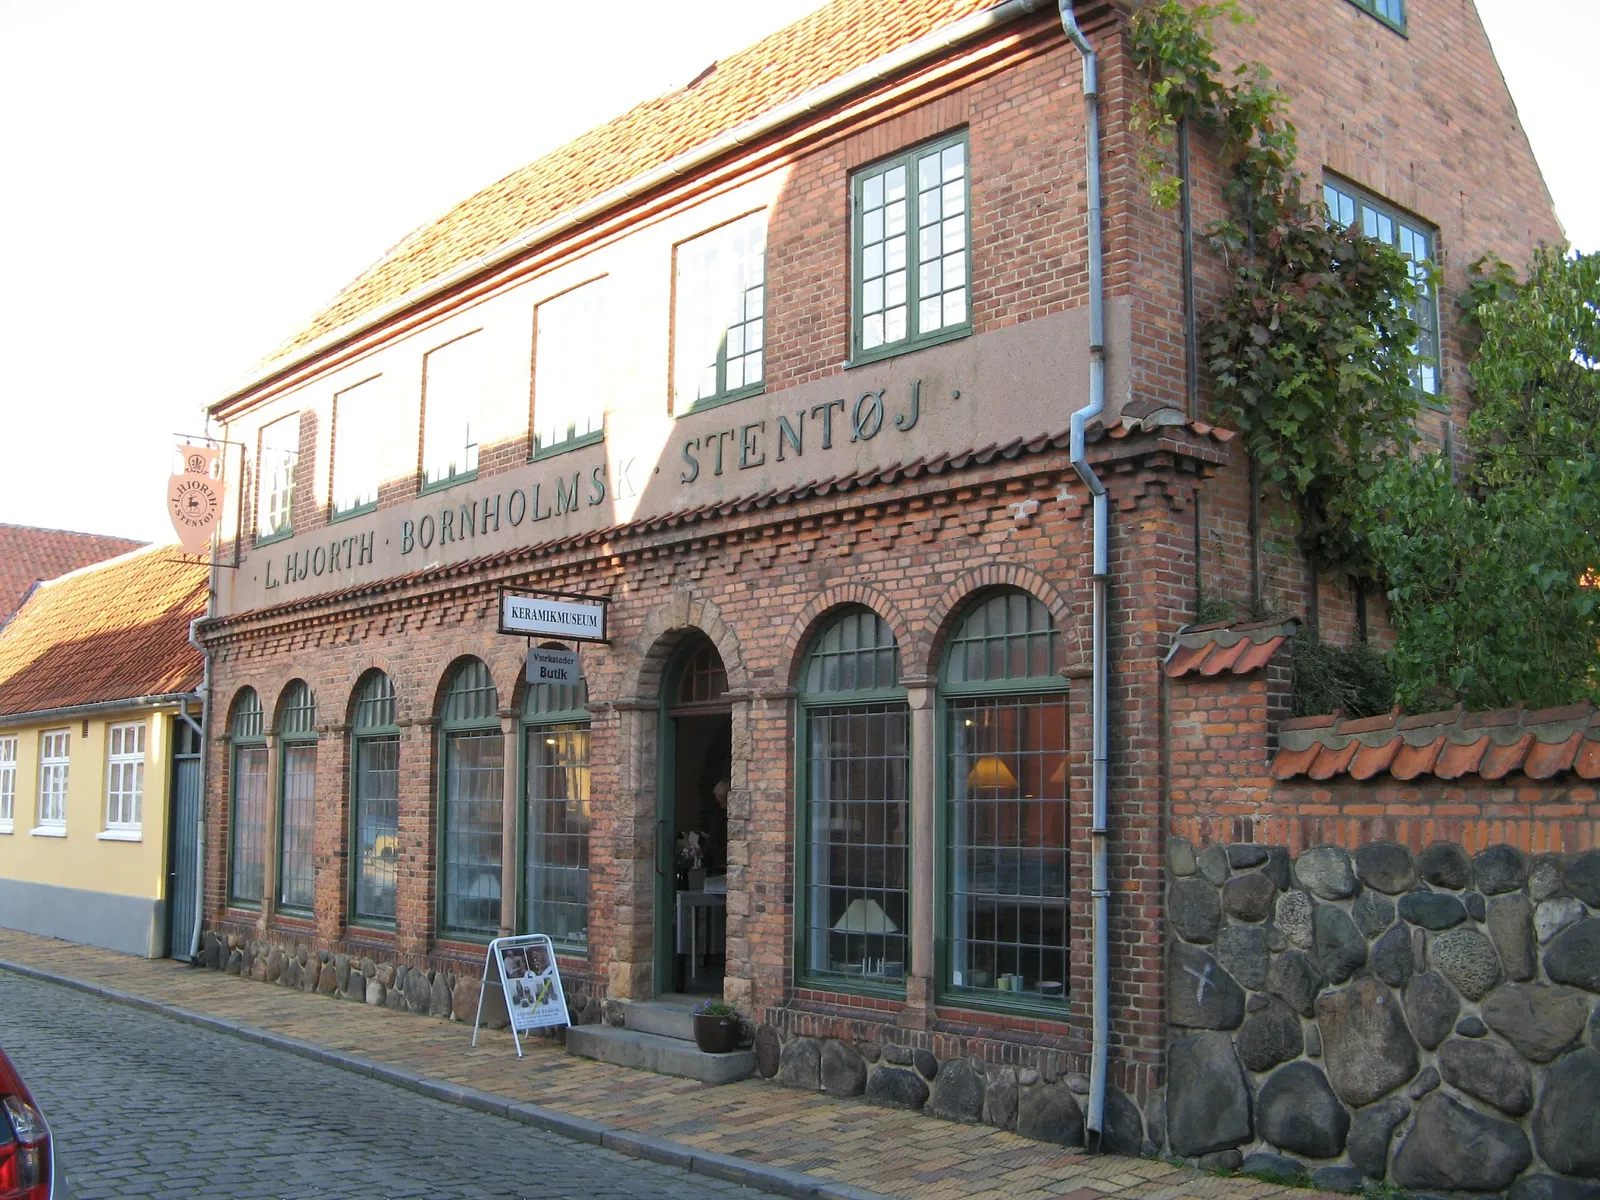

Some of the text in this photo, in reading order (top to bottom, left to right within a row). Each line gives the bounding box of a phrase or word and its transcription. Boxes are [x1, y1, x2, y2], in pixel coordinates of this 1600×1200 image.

[264, 379, 922, 590] L. HJORTH BORNHOLMSK STENTØJ
[511, 606, 598, 627] KERAMIKMUSEUM
[533, 653, 575, 665] Værksteder
[539, 666, 568, 680] Butik
